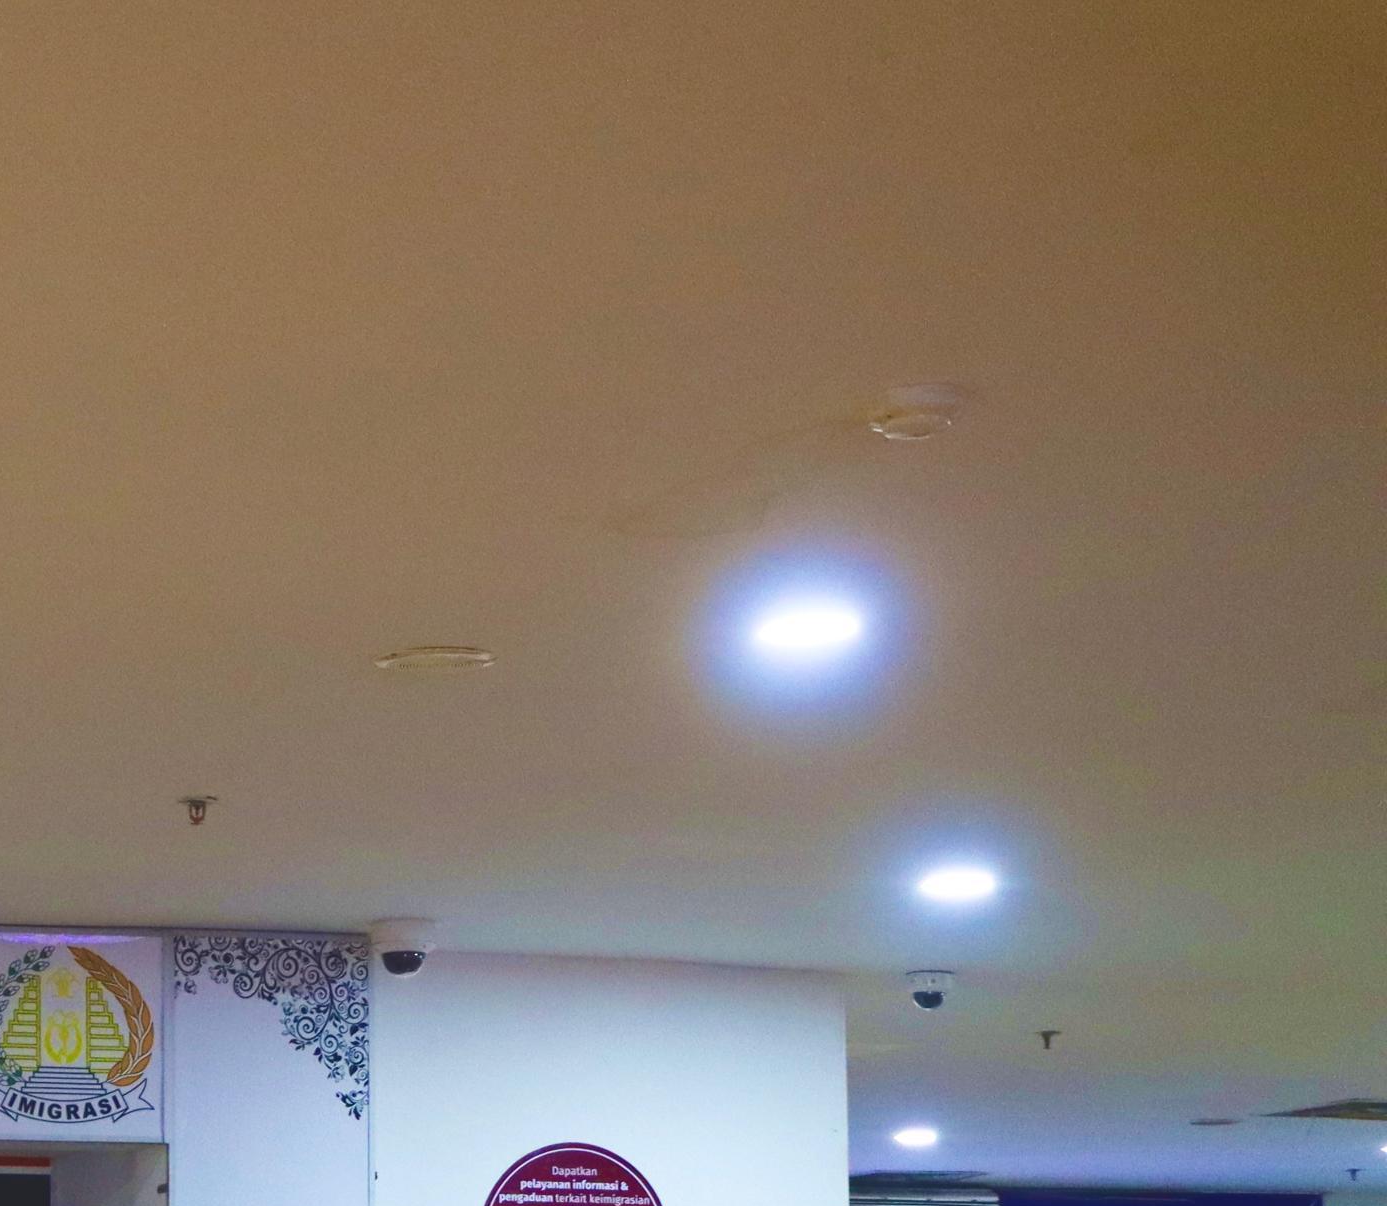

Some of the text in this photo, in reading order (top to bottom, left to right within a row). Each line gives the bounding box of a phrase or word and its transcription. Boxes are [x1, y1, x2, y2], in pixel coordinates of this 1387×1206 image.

[7, 1092, 125, 1122] IMIGRASI
[552, 1166, 598, 1177] Dapatkan
[520, 1179, 629, 1191] pelayanan informasi &
[499, 1193, 650, 1206] pengaduan terkait keimigrasian
